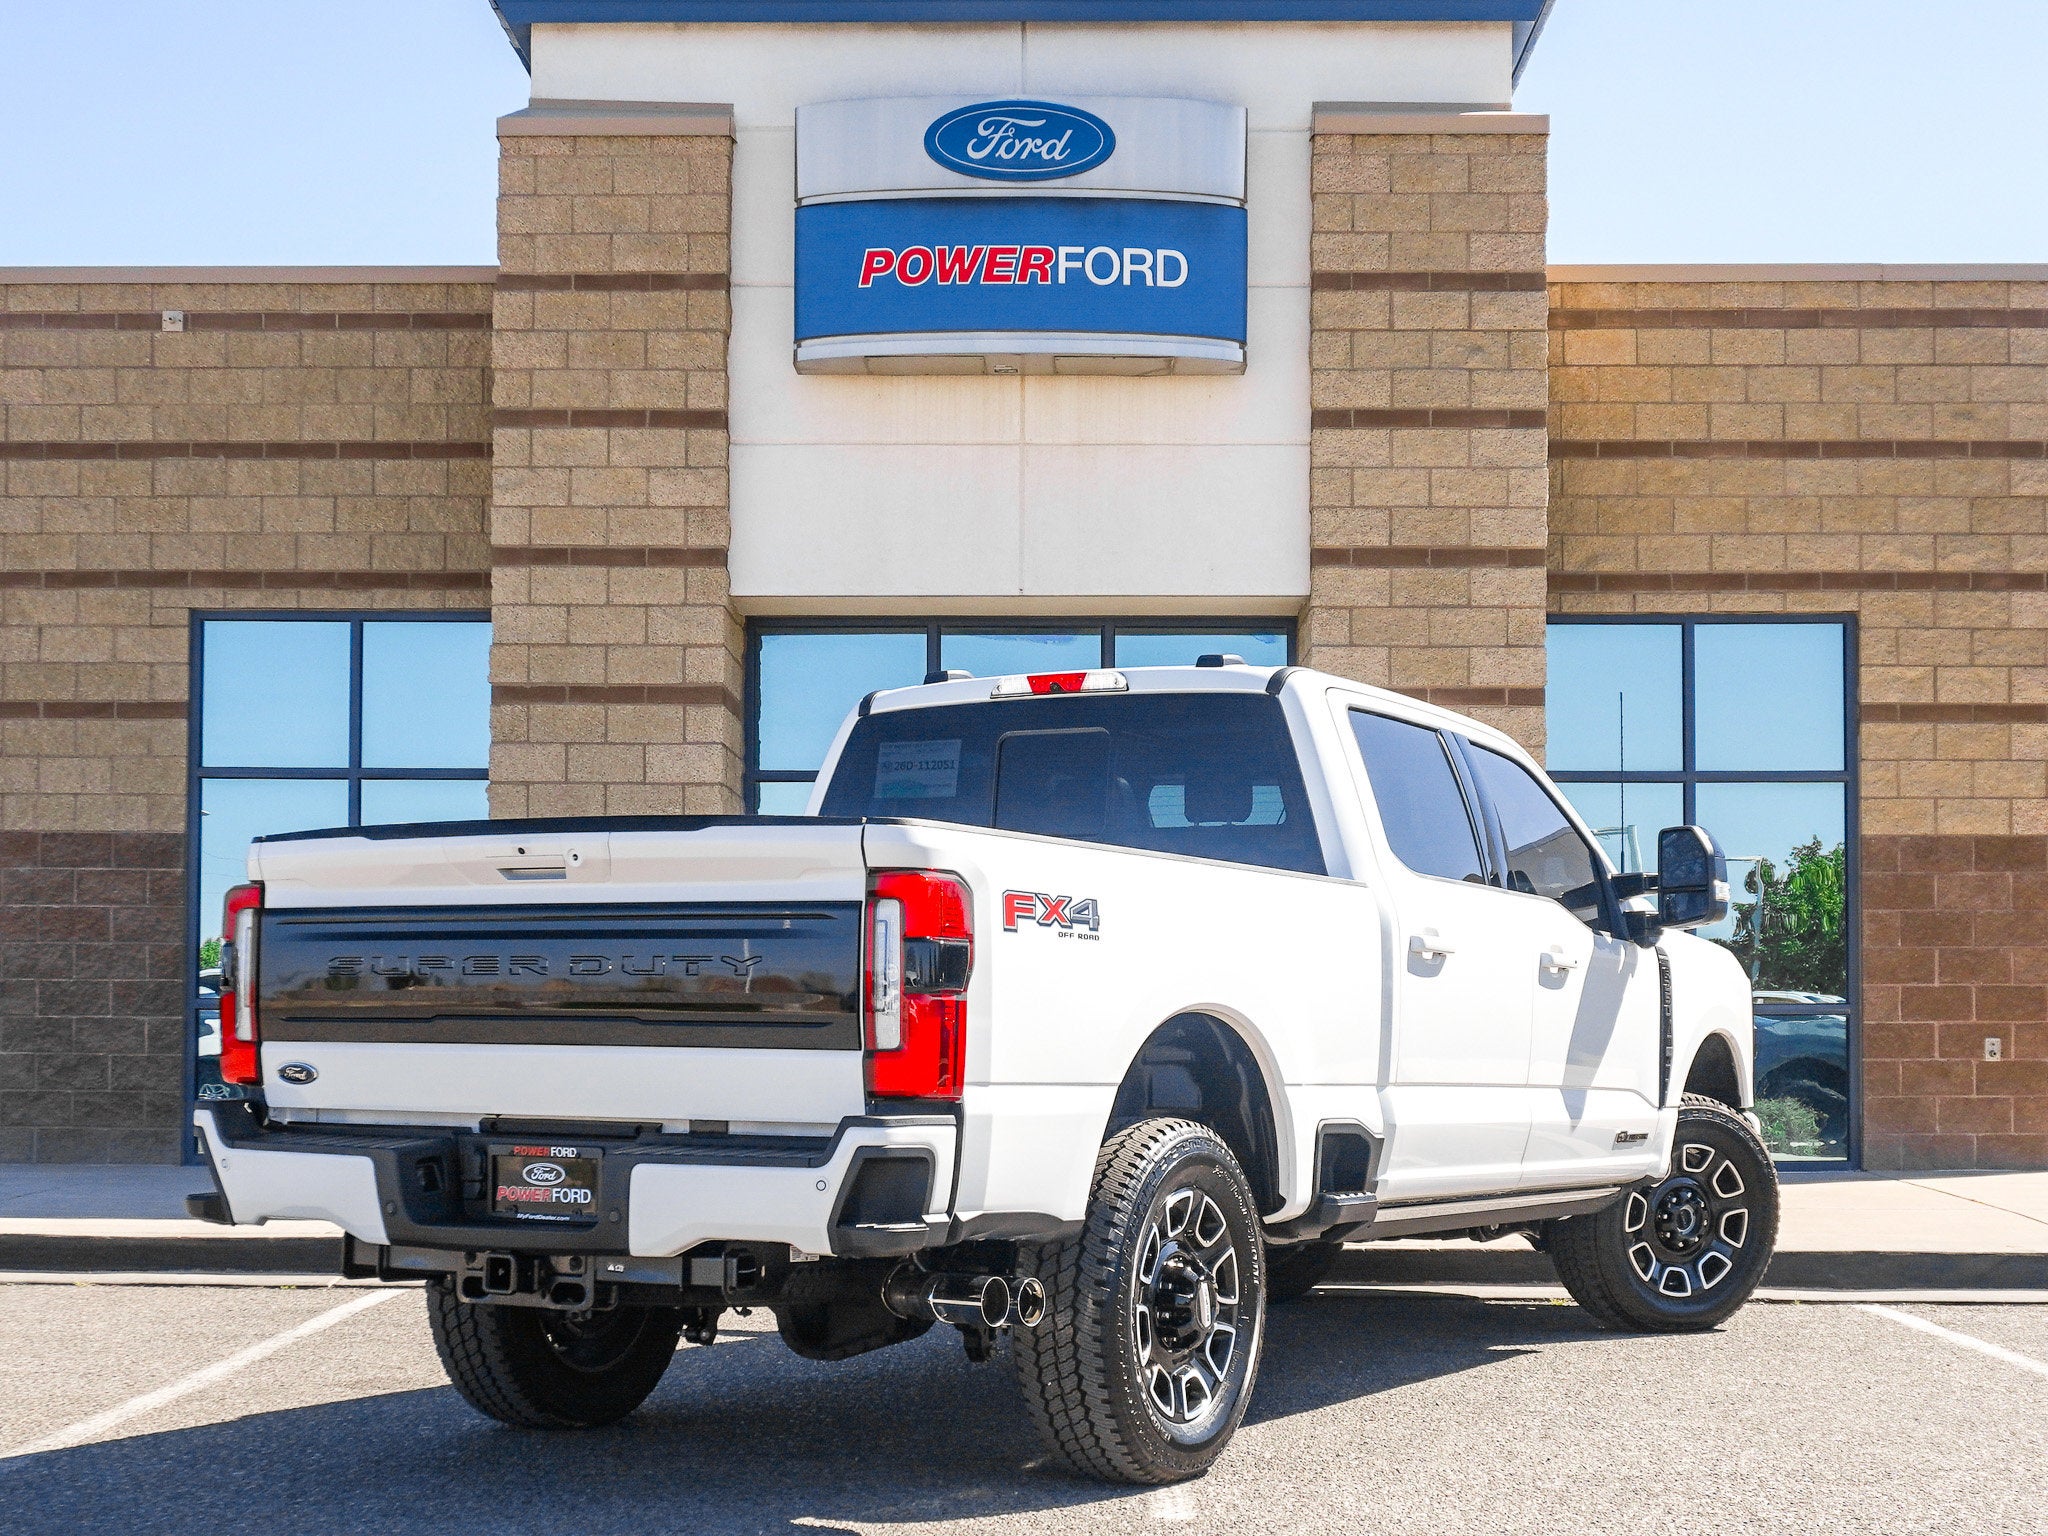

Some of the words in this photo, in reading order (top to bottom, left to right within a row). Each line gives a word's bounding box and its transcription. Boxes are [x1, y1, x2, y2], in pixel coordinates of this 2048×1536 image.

[966, 116, 1072, 162] Ford
[1002, 889, 1100, 933] FX4
[1058, 931, 1075, 939] OFF
[328, 955, 549, 977] SUPER
[569, 955, 763, 977] DUTY
[530, 1166, 557, 1181] Ford
